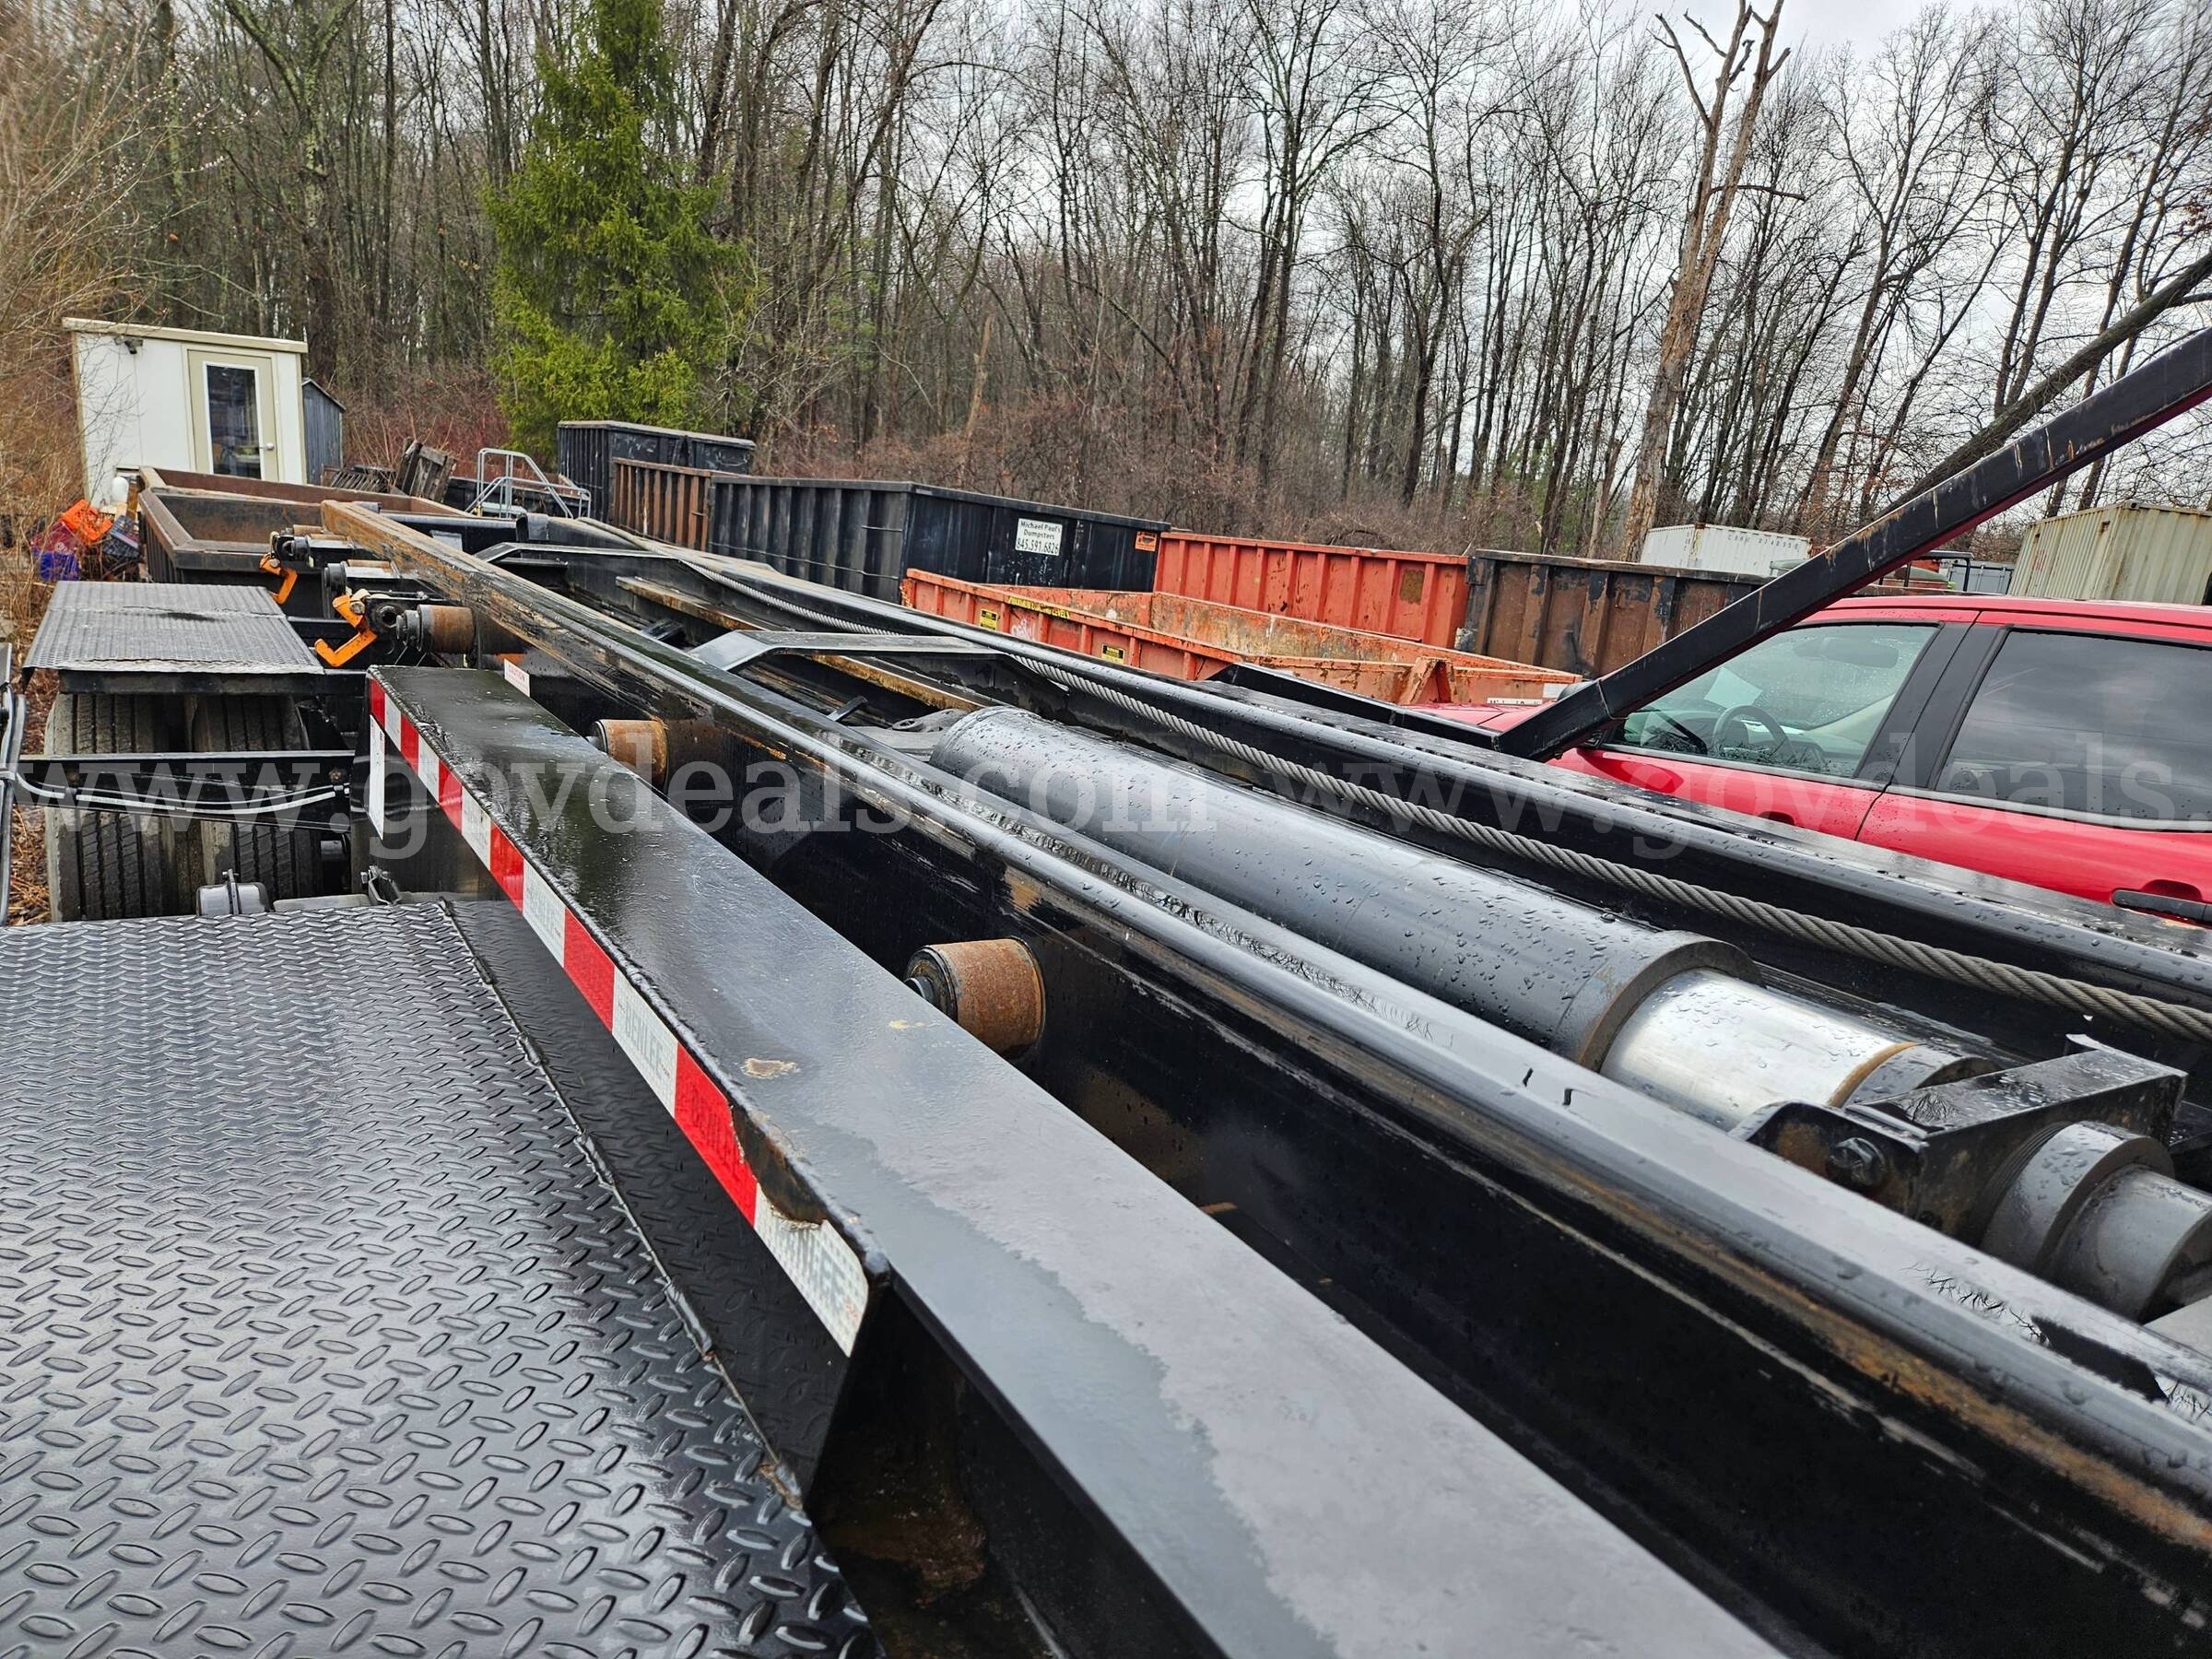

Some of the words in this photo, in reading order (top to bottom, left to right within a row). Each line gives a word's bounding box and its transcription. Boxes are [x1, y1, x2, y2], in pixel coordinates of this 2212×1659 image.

[1020, 520, 1043, 530] Michael
[1044, 523, 1061, 533] Paul's
[1024, 529, 1055, 540] Dumpsters
